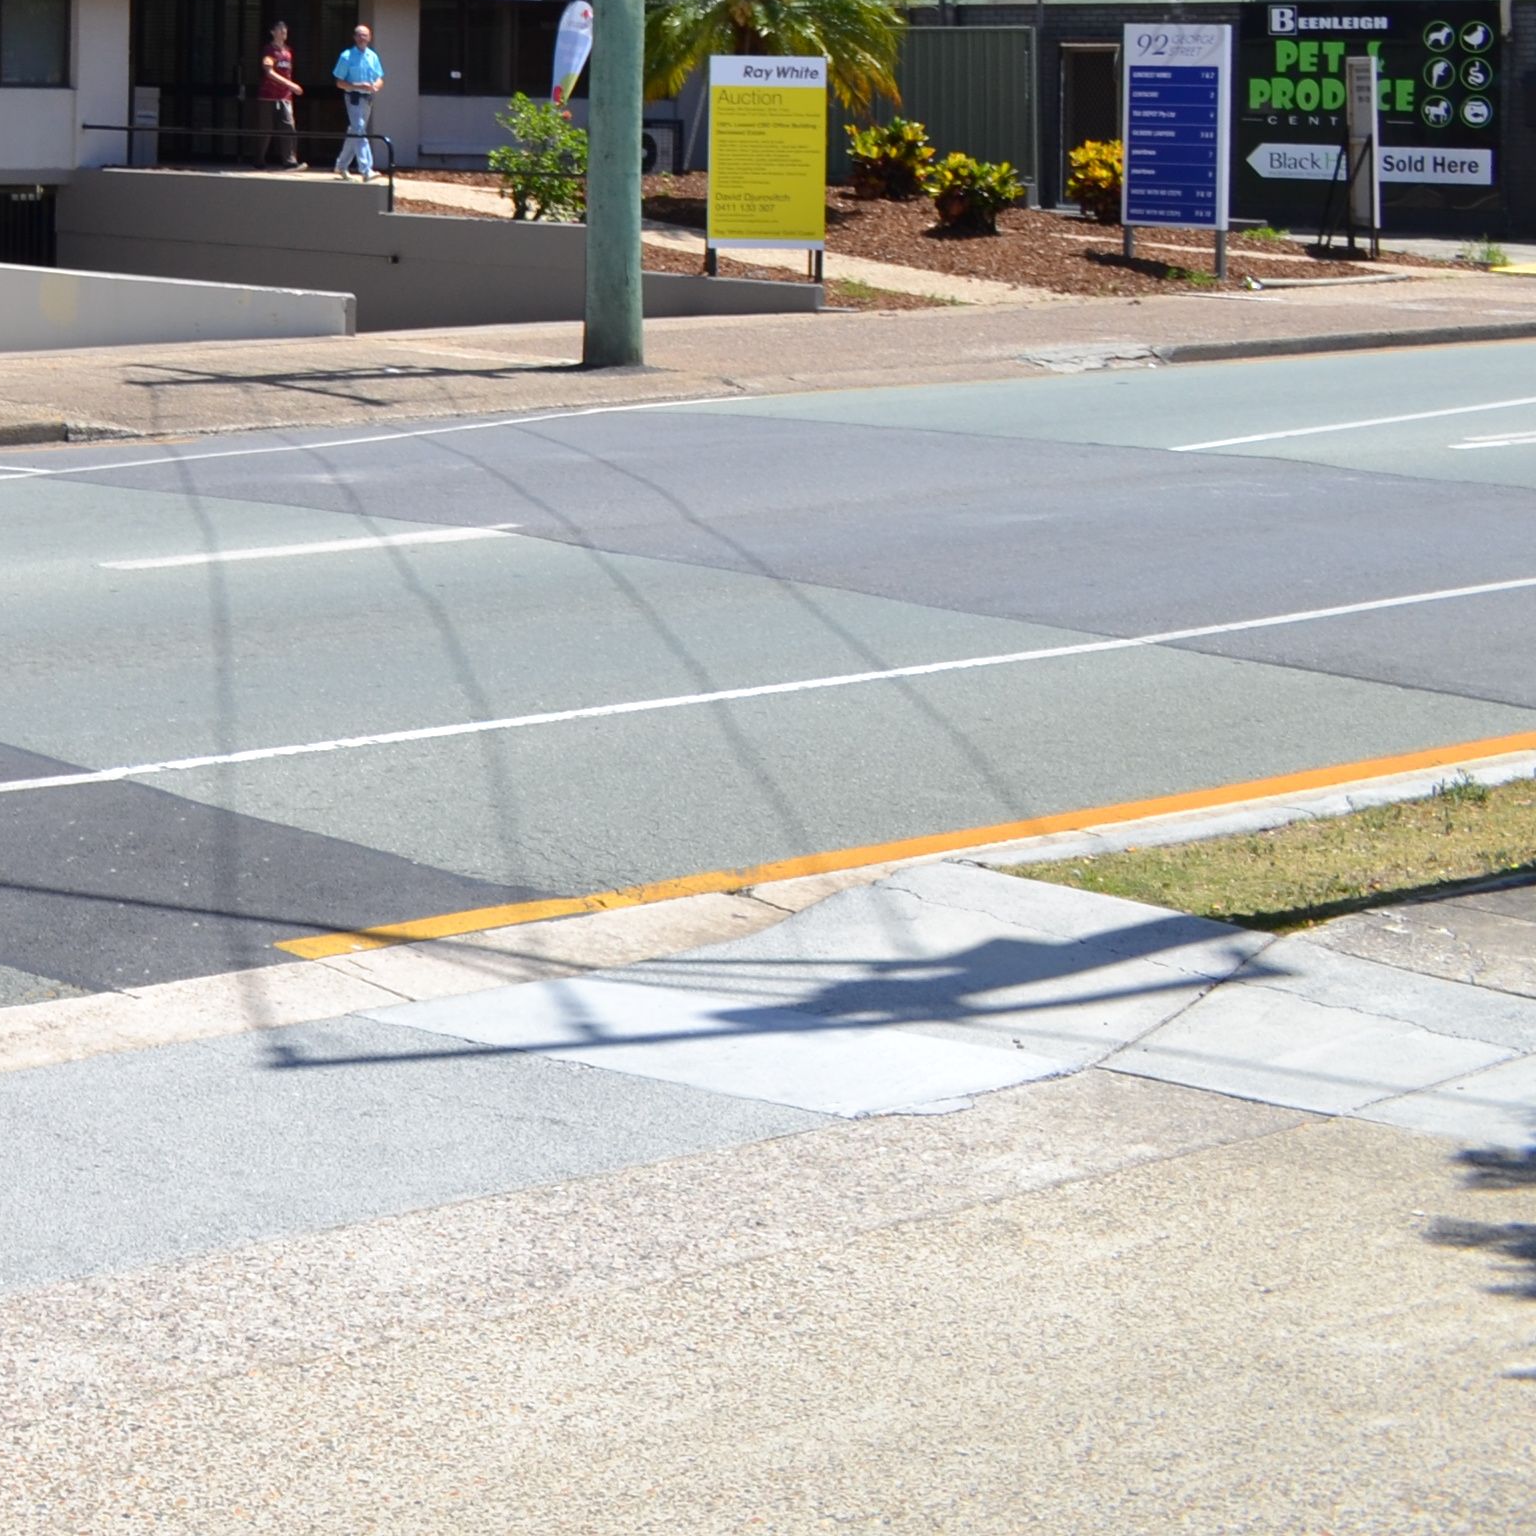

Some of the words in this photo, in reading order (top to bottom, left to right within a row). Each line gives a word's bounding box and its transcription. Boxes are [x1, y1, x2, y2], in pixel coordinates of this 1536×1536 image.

[1269, 7, 1389, 33] BEENLEIGH
[1136, 33, 1169, 58] 92
[1275, 40, 1346, 73] PET
[743, 65, 773, 81] Ray
[776, 66, 819, 80] White
[717, 89, 784, 106] Auction
[1248, 77, 1416, 112] PRODCE
[1269, 151, 1322, 170] Black
[1382, 155, 1425, 173] Sold
[1432, 156, 1480, 174] Here
